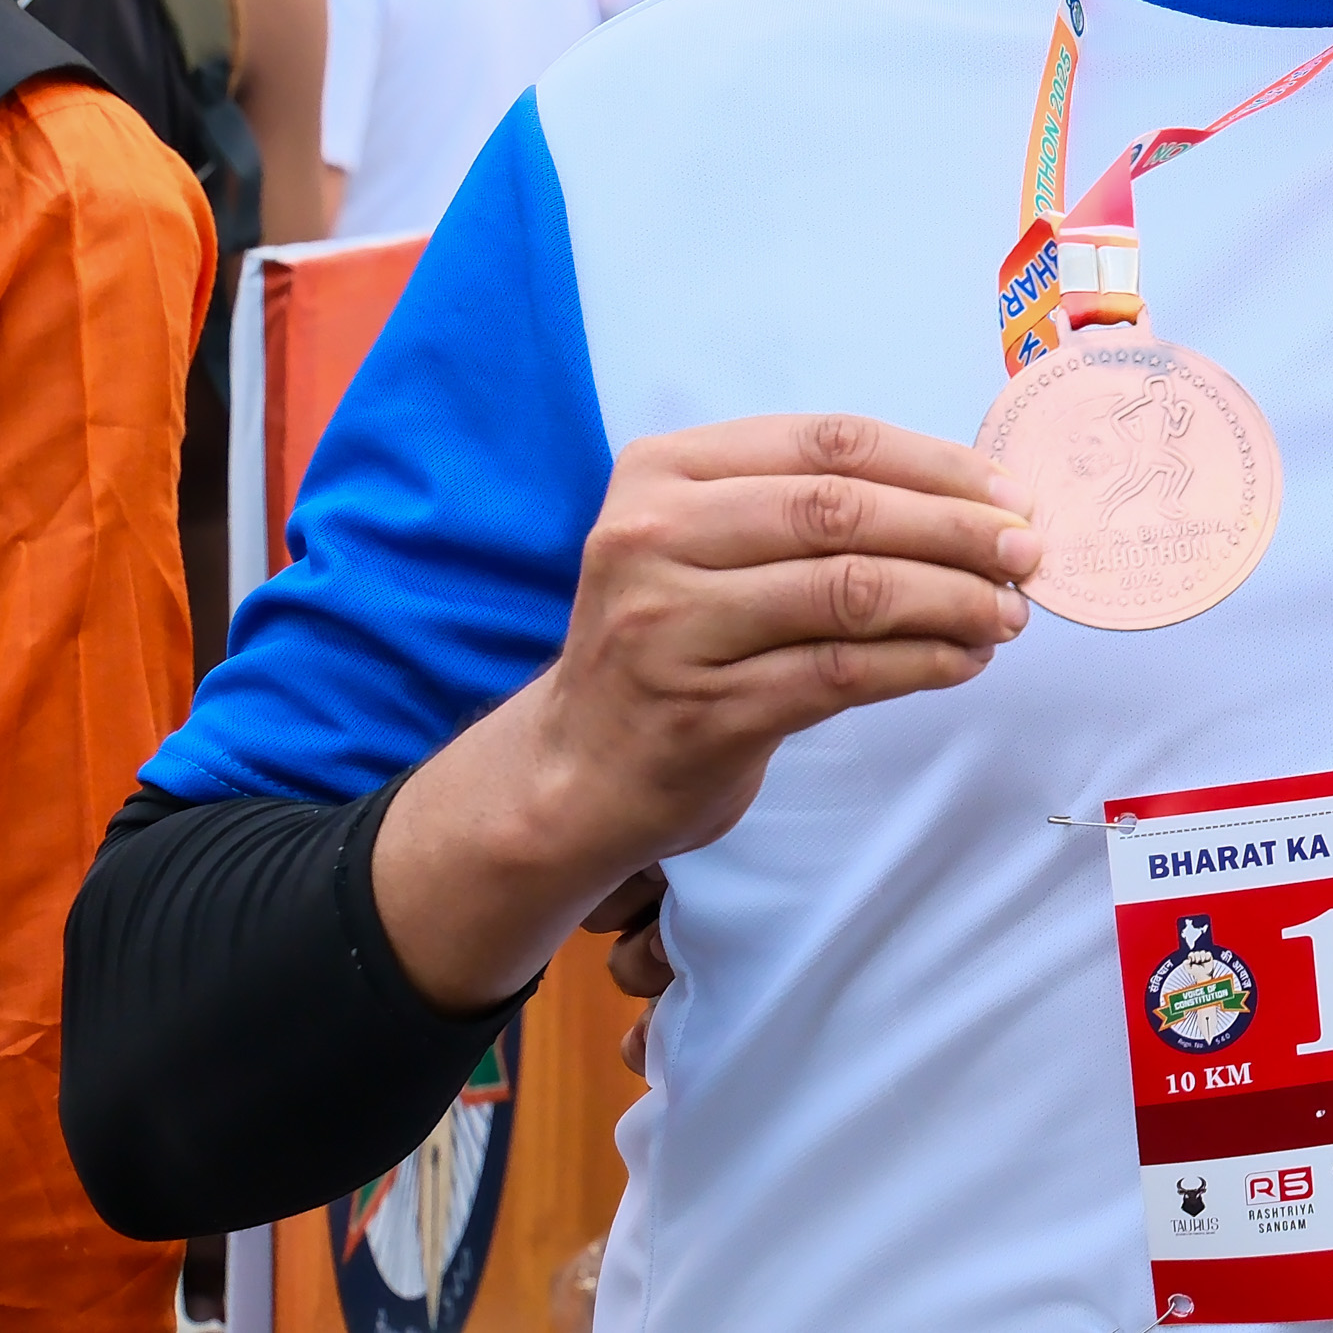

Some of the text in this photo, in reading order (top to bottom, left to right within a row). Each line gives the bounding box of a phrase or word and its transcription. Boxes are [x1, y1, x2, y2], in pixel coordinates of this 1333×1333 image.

[1033, 46, 1071, 218] OTHON 2025
[1063, 538, 1210, 576] SHAHOTHON
[1148, 841, 1277, 880] BHARAT
[1287, 835, 1330, 863] KA
[1174, 989, 1228, 1010] CONSTITUTION
[1182, 984, 1216, 999] VOICE OF
[1165, 1062, 1253, 1095] 10 KM
[1248, 1203, 1314, 1220] RASHTRIYA
[1170, 1218, 1219, 1233] TAURUS
[1259, 1219, 1307, 1234] SANGAM
